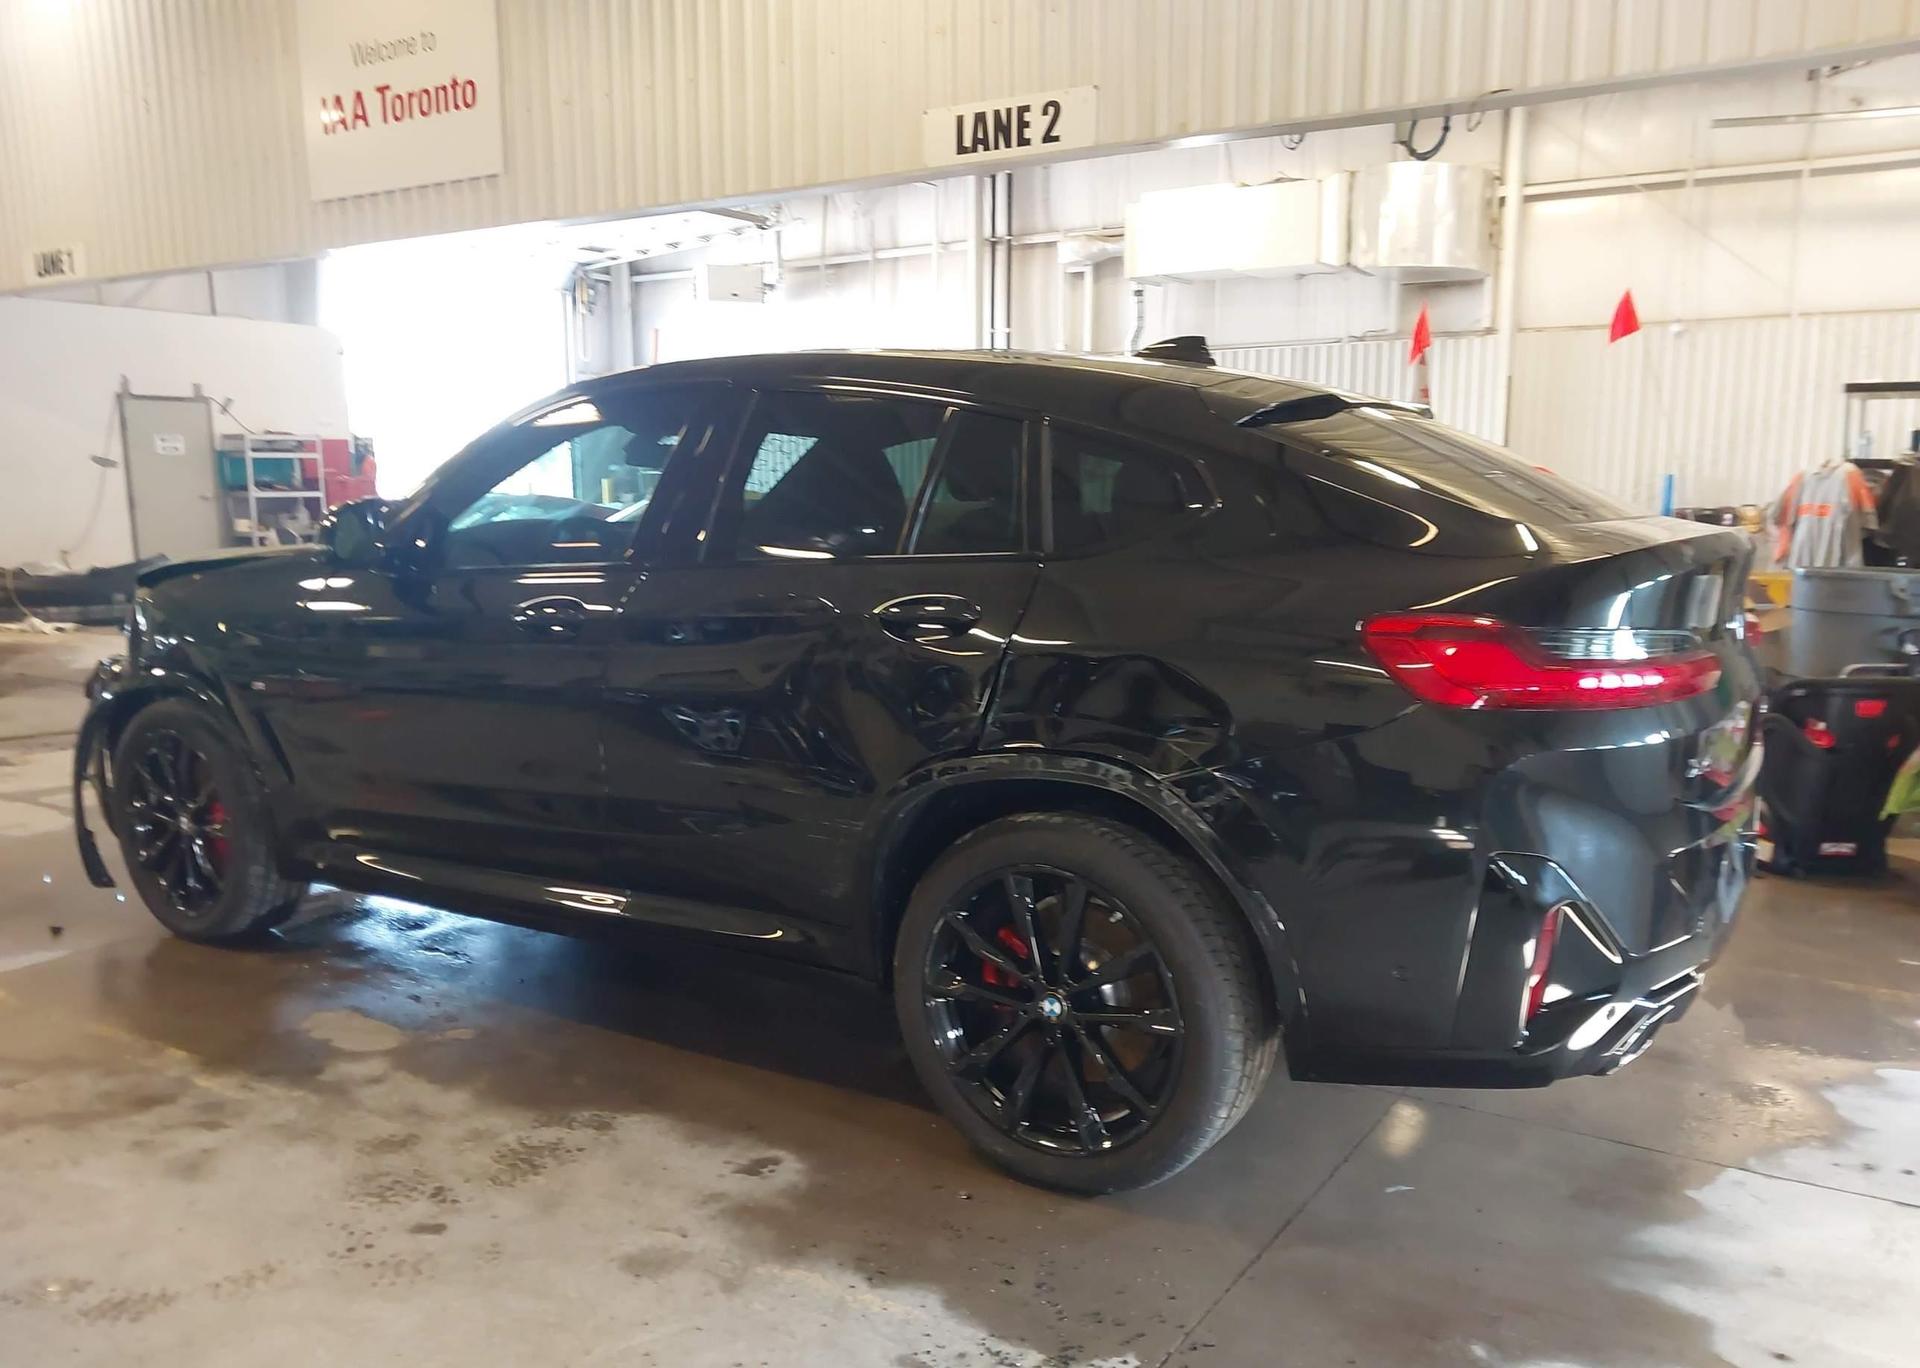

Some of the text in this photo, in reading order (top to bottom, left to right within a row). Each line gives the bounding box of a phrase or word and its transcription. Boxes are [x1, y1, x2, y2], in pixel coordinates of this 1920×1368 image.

[349, 30, 438, 68] Welcome to
[321, 74, 478, 136] IAA Toronto
[956, 99, 1062, 155] LANE 2
[33, 249, 65, 278] LANE
